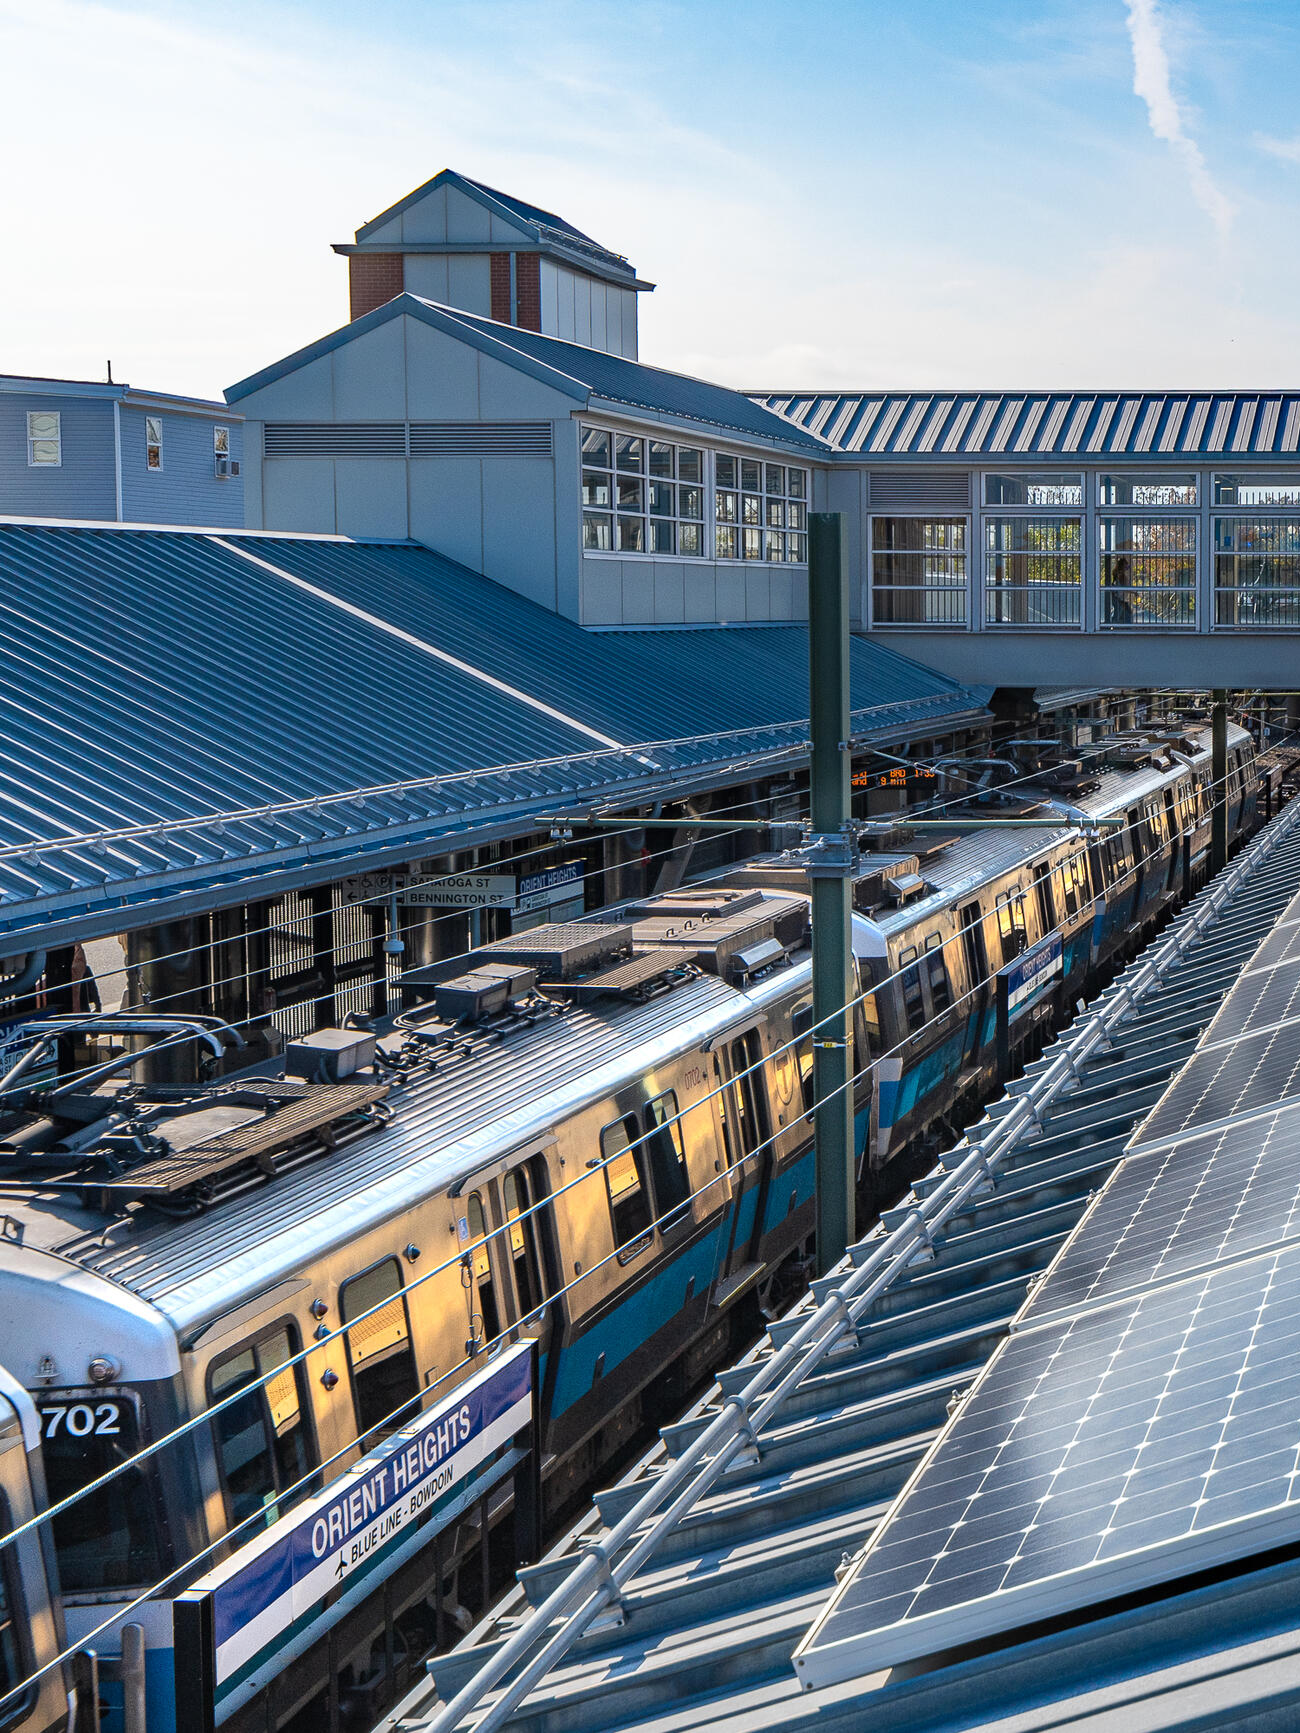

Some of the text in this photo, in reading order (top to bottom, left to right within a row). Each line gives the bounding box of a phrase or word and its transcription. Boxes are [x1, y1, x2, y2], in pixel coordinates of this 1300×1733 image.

[411, 877, 473, 888] SARATOGA
[476, 878, 491, 888] ST
[520, 866, 577, 894] ORIENT HEIGHTS
[411, 893, 505, 904] BENNINGTON ST
[39, 1403, 121, 1438] 702
[311, 1404, 472, 1559] ORIENT HEIGHTS
[351, 1527, 378, 1564] BLUE
[380, 1507, 402, 1540] LINE
[409, 1463, 454, 1515] BOWDOIN
